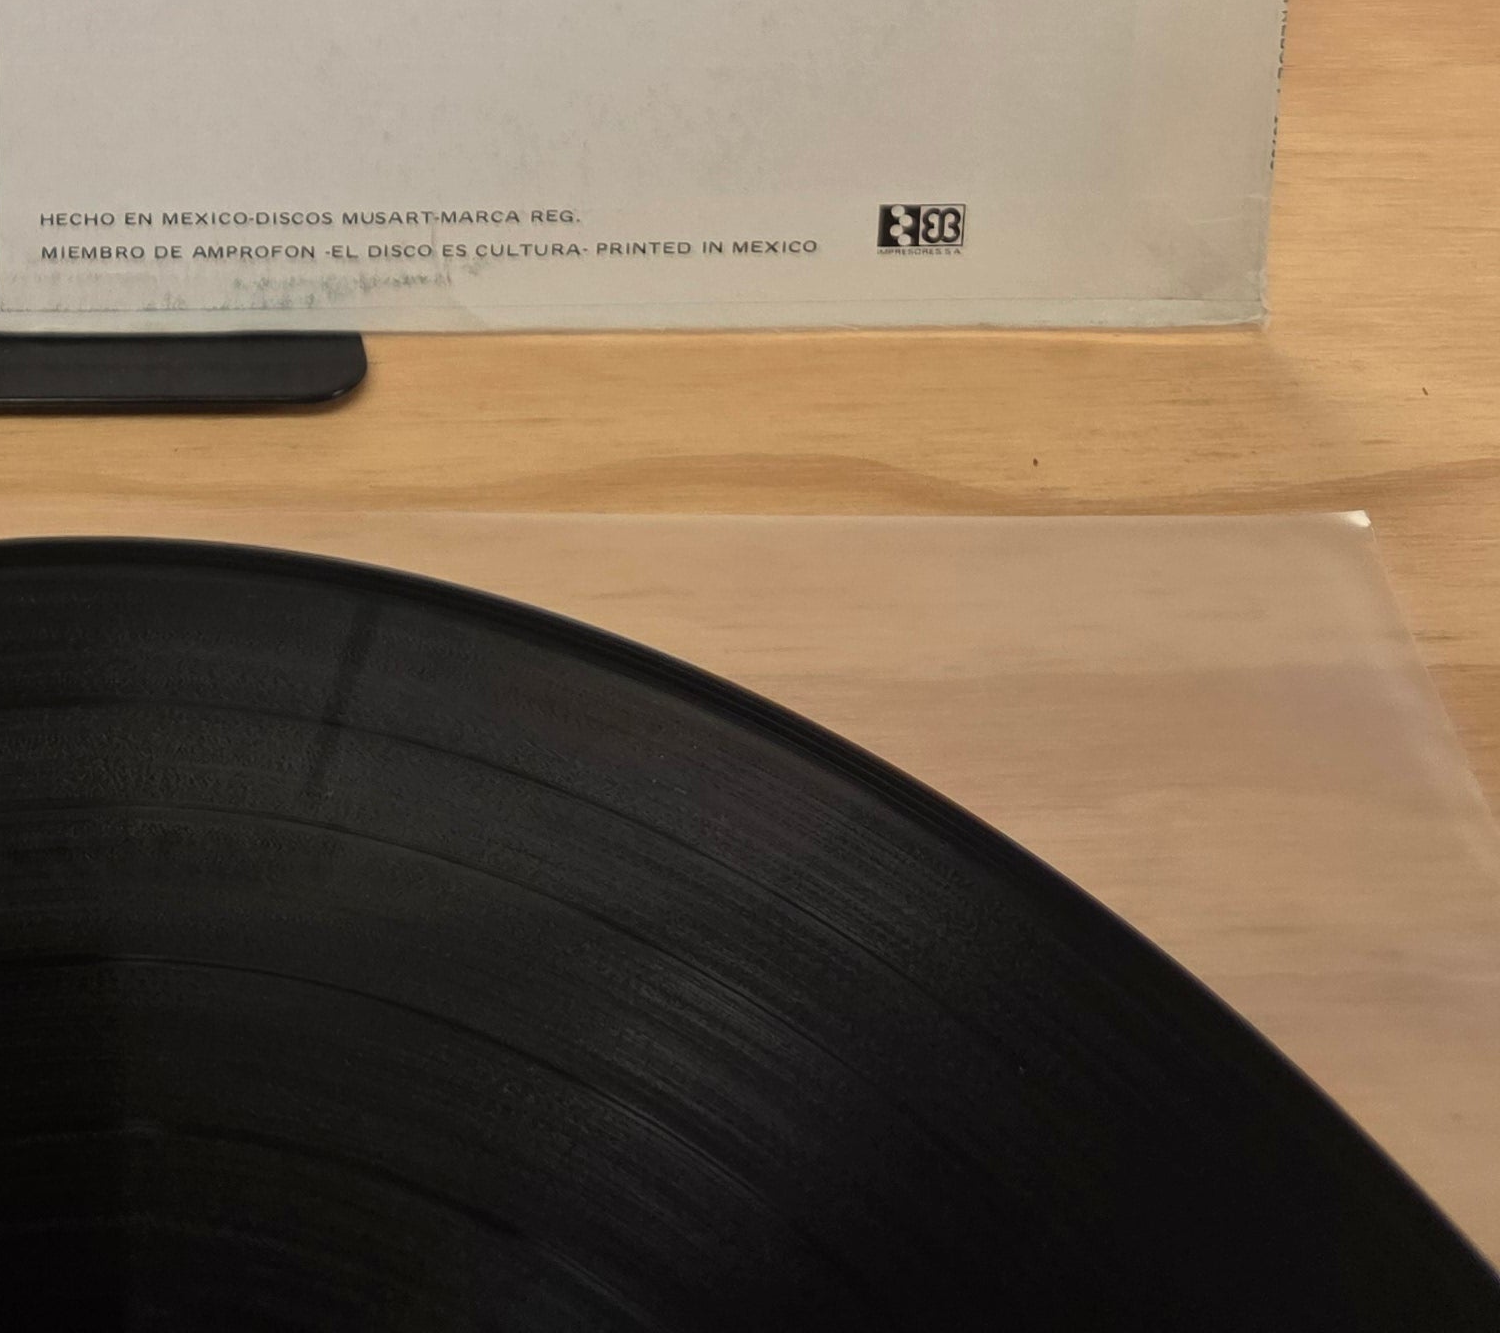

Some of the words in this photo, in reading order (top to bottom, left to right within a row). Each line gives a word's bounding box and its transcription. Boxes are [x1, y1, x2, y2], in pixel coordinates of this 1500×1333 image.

[40, 213, 115, 226] HECHO
[124, 212, 152, 226] EN
[531, 209, 581, 223] REG.
[41, 246, 145, 260] MIEMBRO
[154, 245, 182, 260] DE
[192, 245, 315, 260] AMPROFON
[368, 244, 433, 258] DISCO
[442, 244, 467, 258] ES
[596, 241, 692, 255] PRINTED
[702, 241, 723, 254] IN
[732, 240, 817, 254] MEXICO
